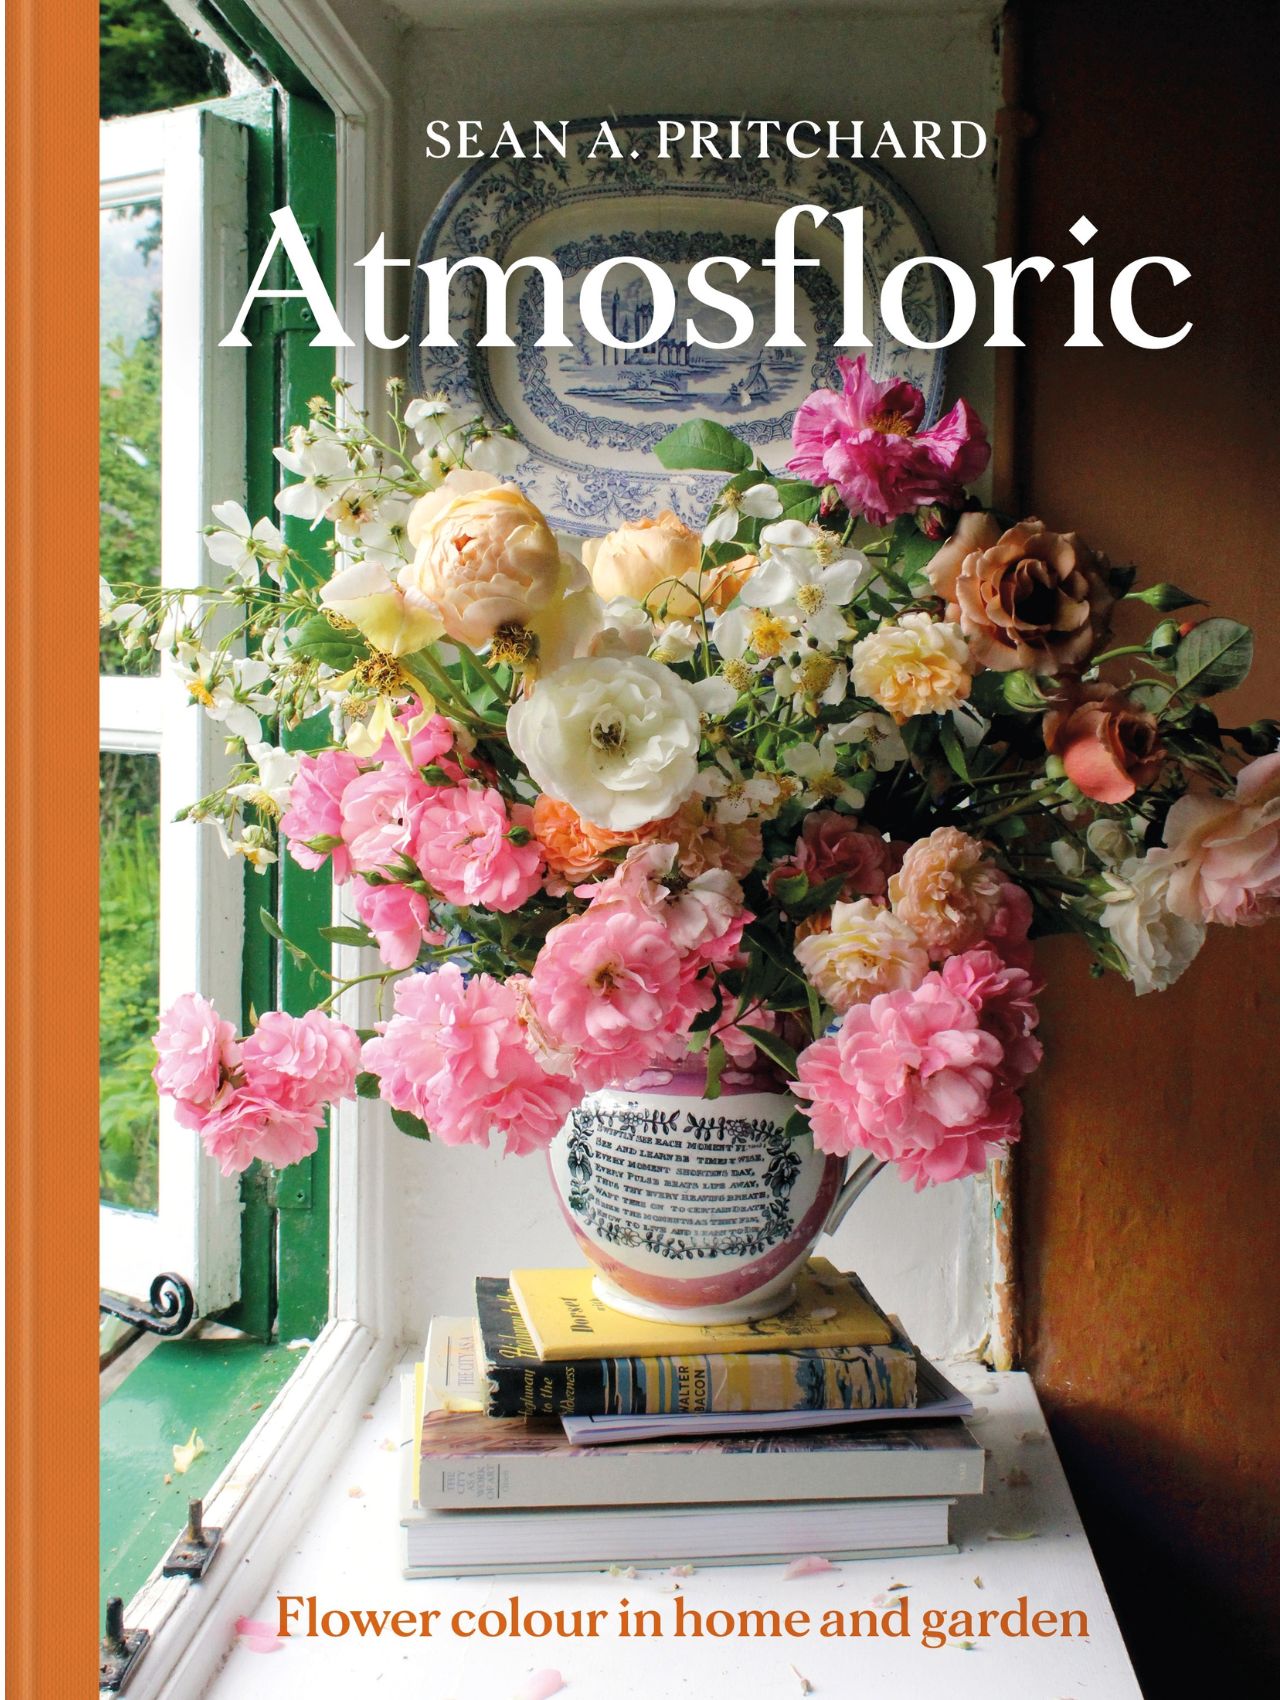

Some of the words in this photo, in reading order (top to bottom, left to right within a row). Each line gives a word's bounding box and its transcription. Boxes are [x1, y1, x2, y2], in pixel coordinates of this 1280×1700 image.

[596, 1137, 612, 1149] SEE
[616, 1145, 637, 1155] AND
[640, 1150, 674, 1161] LEARN
[675, 1154, 689, 1162] BE
[636, 1135, 653, 1145] SEE
[655, 1138, 682, 1148] EACH
[687, 1141, 733, 1151] MOMENT
[595, 1150, 625, 1166] EVERY
[627, 1160, 671, 1174] MOMENT
[676, 1168, 729, 1177] SHORTENS
[730, 1168, 756, 1177] DAY,
[595, 1163, 624, 1178] EVERY
[627, 1172, 660, 1185] PULSE
[729, 1180, 760, 1189] AWAY,
[596, 1175, 620, 1190] THUS
[623, 1184, 644, 1195] THY
[646, 1190, 679, 1200] EVERY
[622, 1208, 642, 1219] THE
[670, 1205, 686, 1213] TO
[625, 1220, 640, 1229] TO
[559, 1296, 594, 1334] Dorset
[539, 1376, 553, 1399] the
[694, 1369, 706, 1412] BACON
[541, 1402, 553, 1413] to
